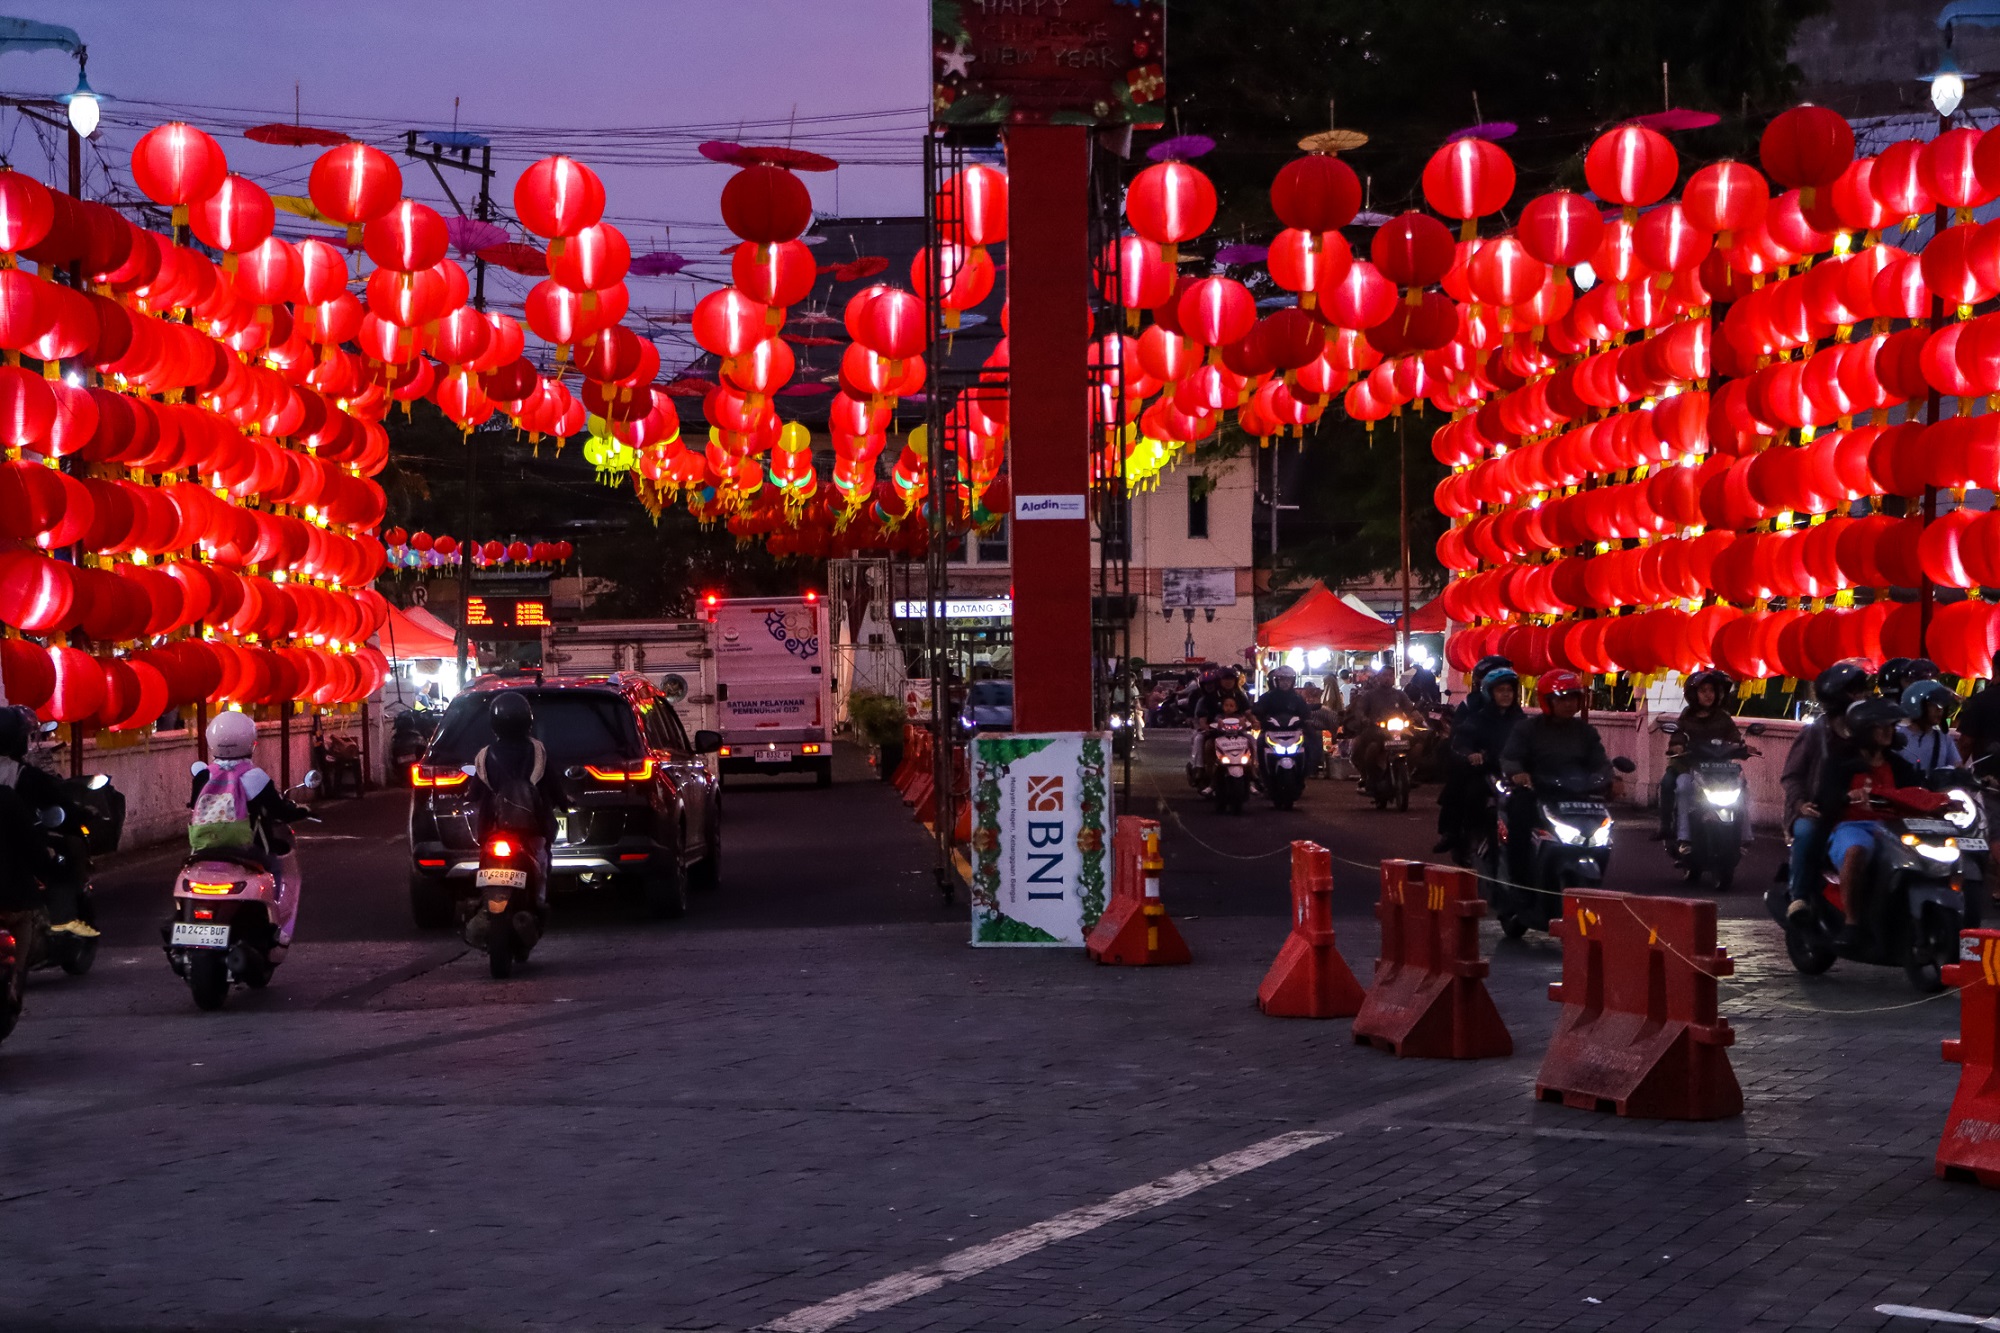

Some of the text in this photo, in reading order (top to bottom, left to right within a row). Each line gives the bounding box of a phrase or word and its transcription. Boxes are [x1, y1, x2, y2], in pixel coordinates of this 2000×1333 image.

[982, 0, 1068, 17] HAPPY
[982, 45, 1120, 69] NEW YEAR
[1021, 499, 1059, 512] Aladin
[900, 603, 993, 614] SELAAT DATANG
[727, 699, 805, 708] SATUAN PELAYANAN
[1009, 808, 1017, 833] Negeri,
[1009, 834, 1017, 877] Kebanggaan
[1027, 820, 1063, 901] BNI
[175, 925, 227, 936] AD 2425 BUF
